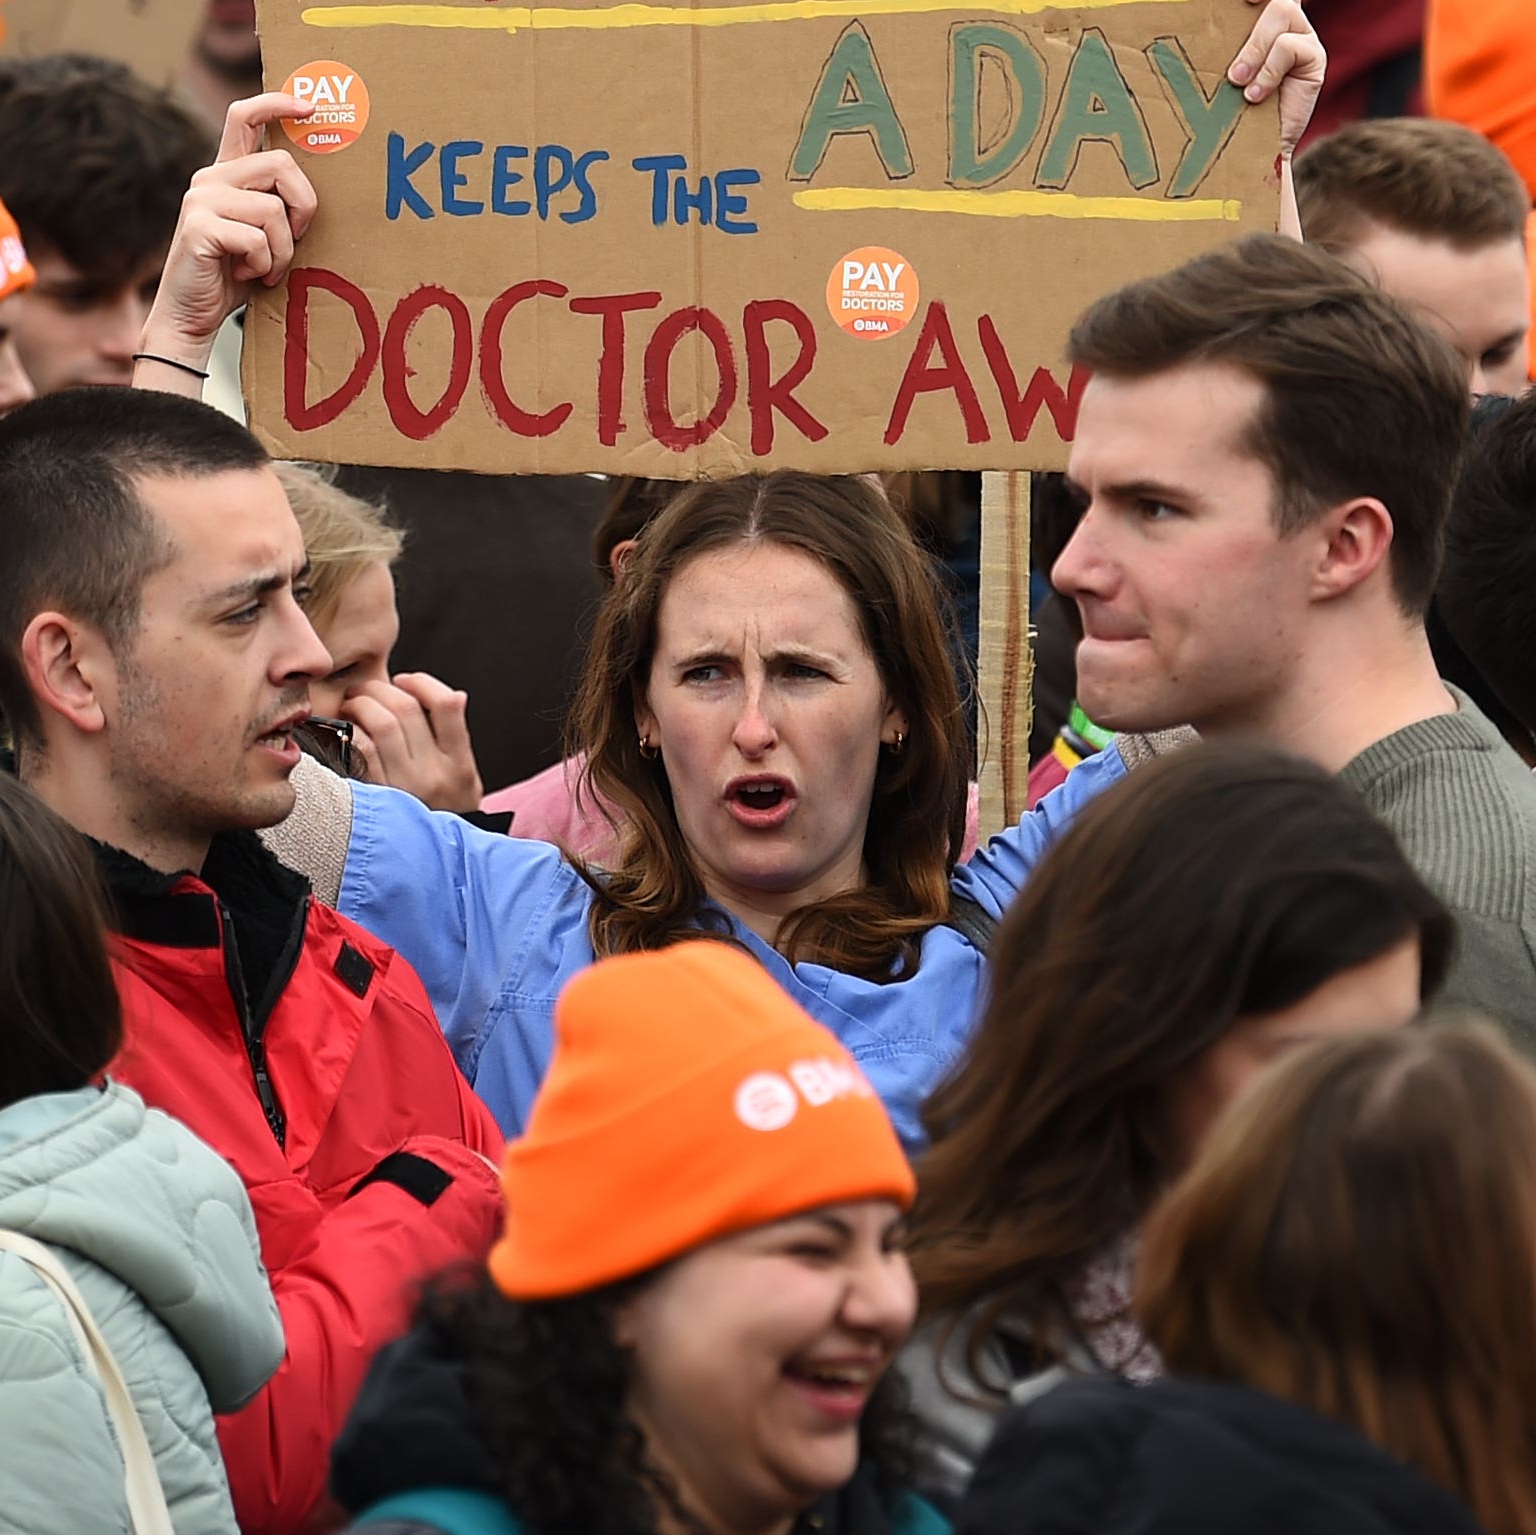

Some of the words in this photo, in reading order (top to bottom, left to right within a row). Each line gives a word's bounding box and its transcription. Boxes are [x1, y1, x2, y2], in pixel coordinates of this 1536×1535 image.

[293, 75, 354, 104] PAY
[787, 18, 914, 180] A
[945, 20, 1250, 199] DAY
[319, 134, 342, 145] BMA
[386, 131, 610, 225] KEEPS
[633, 153, 761, 234] THE
[842, 261, 905, 291] PAY
[841, 298, 904, 312] DOCTORS
[865, 320, 888, 332] BMA
[284, 267, 828, 456] DOCTOR
